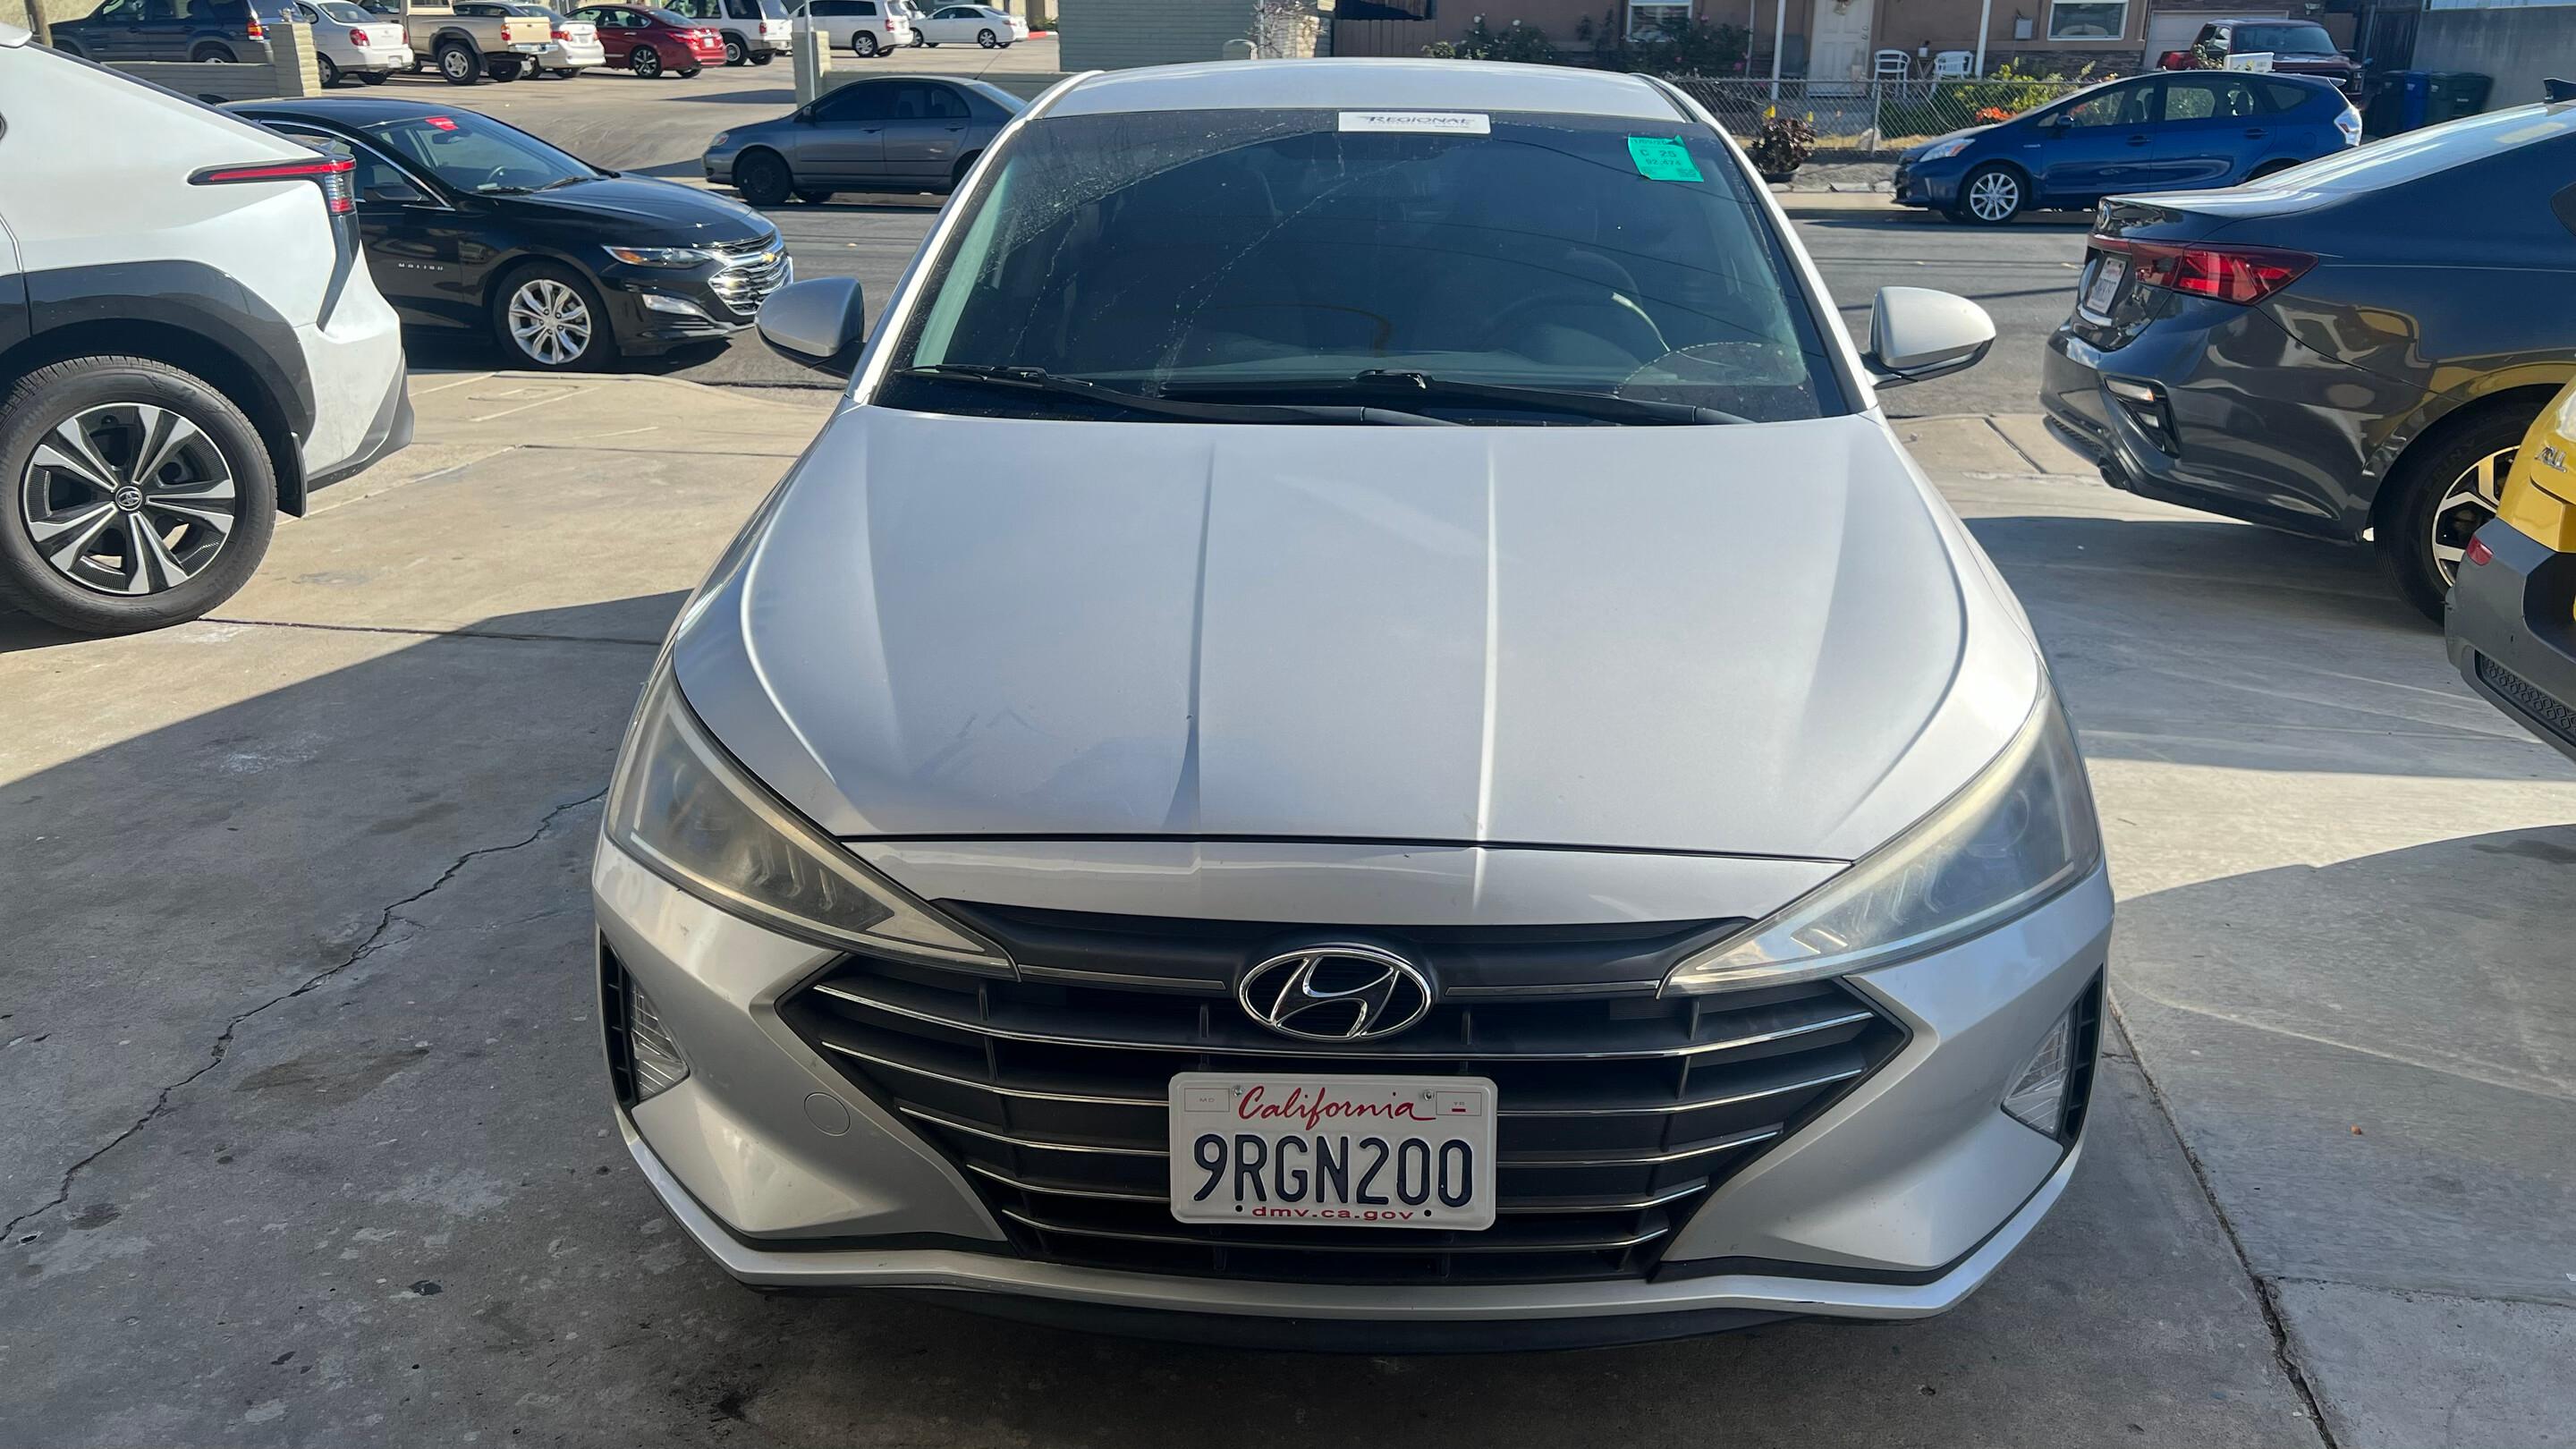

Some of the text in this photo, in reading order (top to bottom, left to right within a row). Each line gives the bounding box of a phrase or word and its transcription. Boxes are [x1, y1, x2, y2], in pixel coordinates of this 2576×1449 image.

[1365, 115, 1472, 124] REGIONAL
[1238, 1085, 1436, 1131] California
[1193, 1133, 1474, 1208] 9RGN200
[1251, 1206, 1414, 1221] dmv.ca.gov
